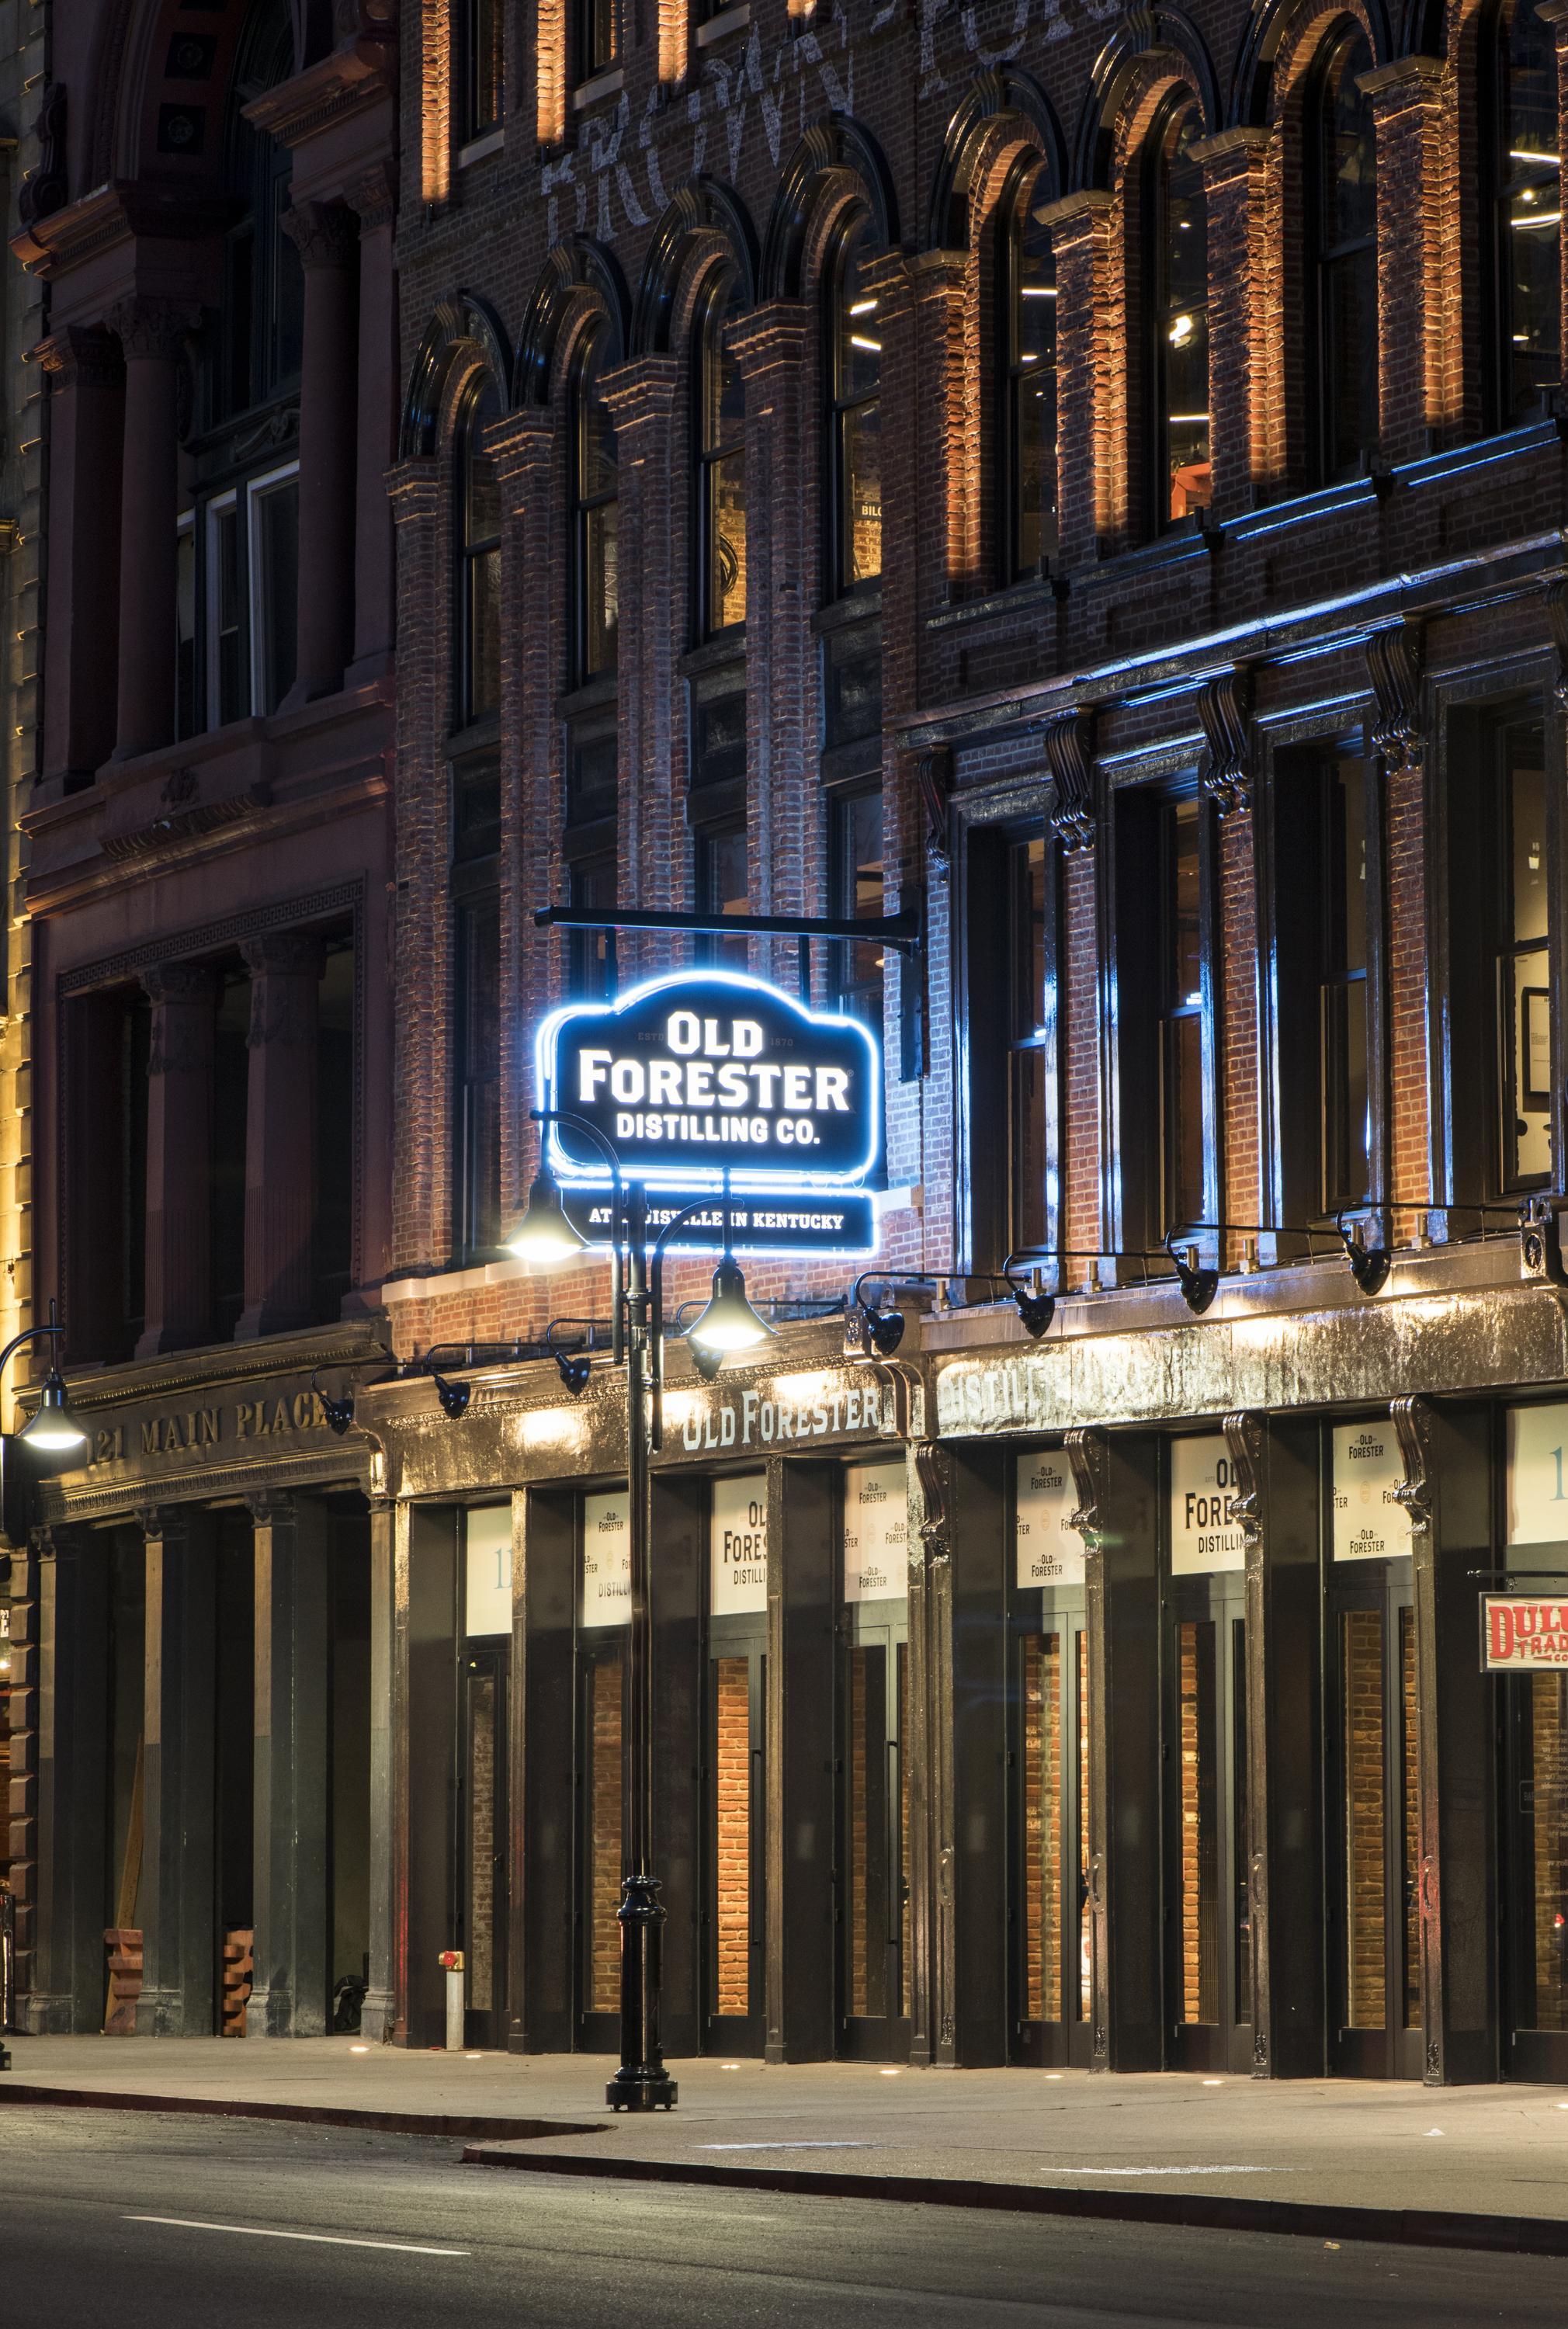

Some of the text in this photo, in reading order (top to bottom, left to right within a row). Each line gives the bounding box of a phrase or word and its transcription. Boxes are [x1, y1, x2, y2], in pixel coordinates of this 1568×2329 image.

[668, 1011, 763, 1057] OLD
[579, 1050, 850, 1111] FORESTER
[616, 1112, 820, 1144] DISTILLING CO.
[588, 1208, 612, 1224] AT
[752, 1212, 844, 1230] KENTUCKY
[140, 1406, 223, 1456] MAIN
[236, 1390, 328, 1440] PLACE
[682, 1405, 736, 1452] OLD
[741, 1390, 879, 1445] FORESTER
[1360, 1434, 1373, 1446] OLD
[1348, 1445, 1384, 1460] FORESTER
[1040, 1466, 1053, 1477] OLD
[868, 1482, 879, 1492] OLD
[1031, 1477, 1063, 1490] FORESTER
[859, 1492, 887, 1504] FORESTER
[606, 1512, 616, 1522] OLD
[598, 1522, 623, 1532] FORESTER
[894, 1522, 905, 1532] OLD
[1361, 1529, 1374, 1539] OLD
[1350, 1540, 1385, 1554] FORESTER
[1041, 1553, 1053, 1564] OLD
[868, 1567, 879, 1576] OLD
[1032, 1565, 1063, 1577] FORESTER
[859, 1577, 887, 1588] FORESTER
